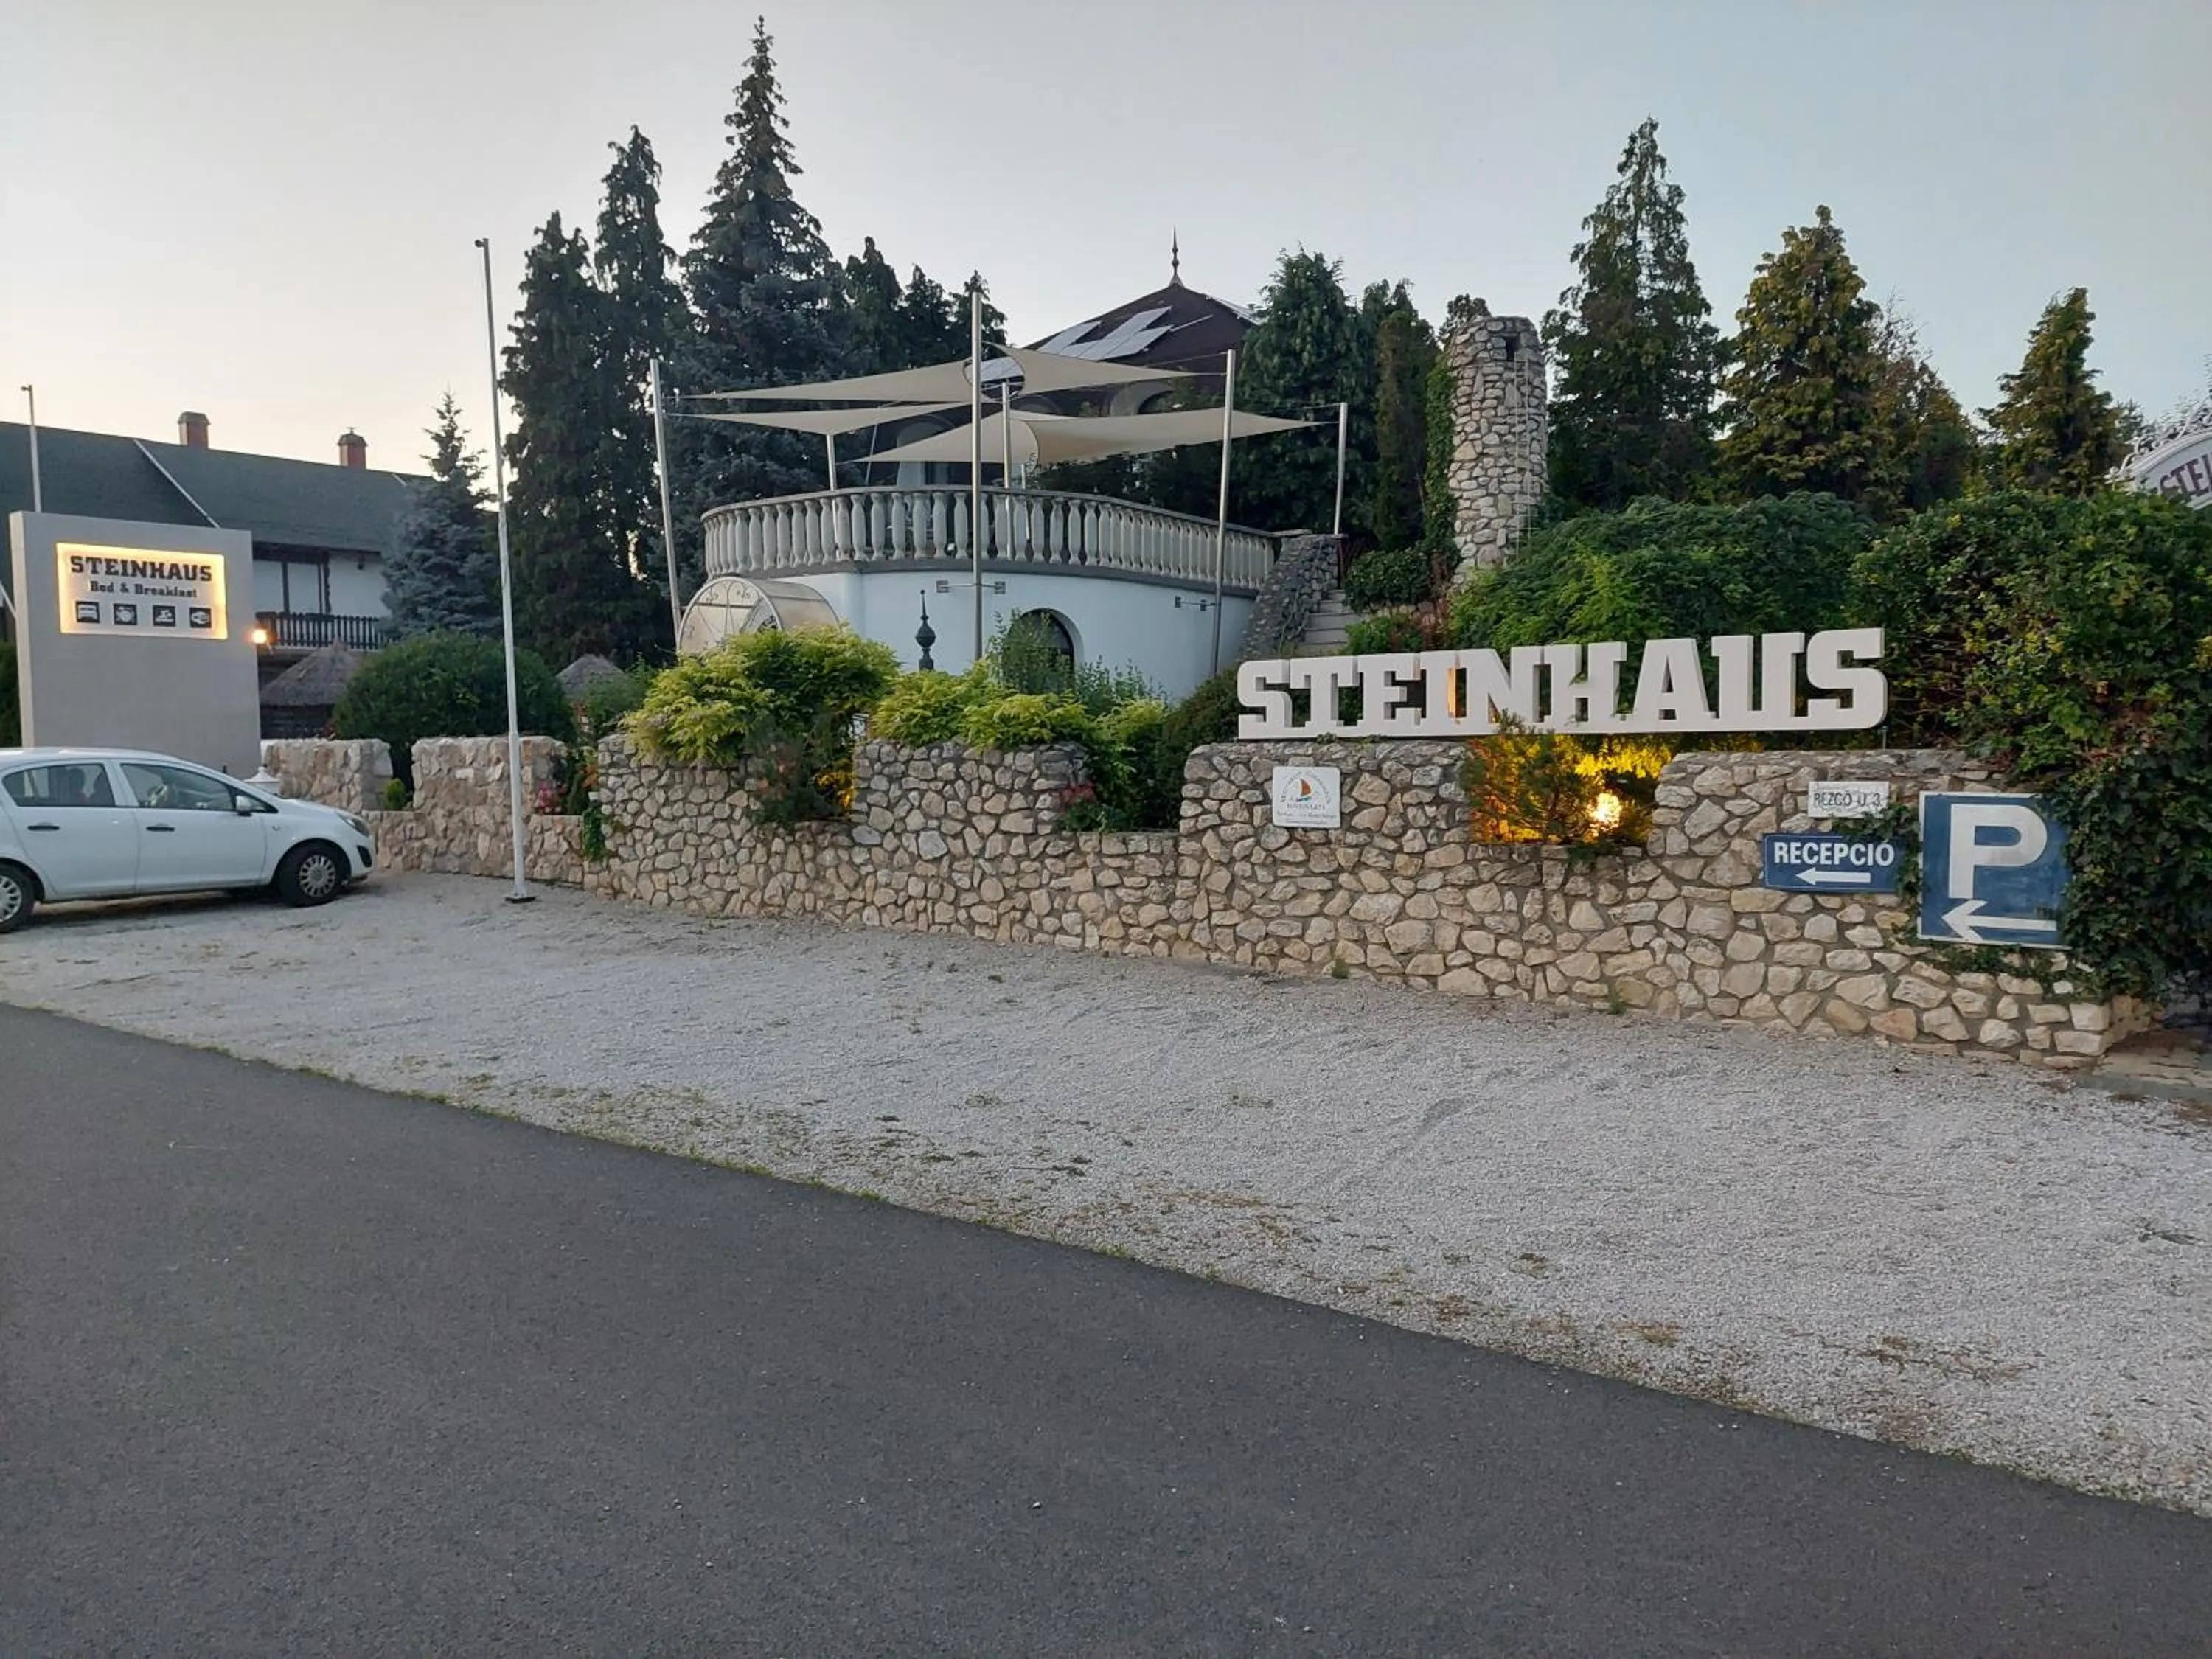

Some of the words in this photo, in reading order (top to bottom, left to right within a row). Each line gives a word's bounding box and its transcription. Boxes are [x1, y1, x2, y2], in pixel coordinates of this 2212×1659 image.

[70, 555, 212, 582] STEINHAUS
[90, 580, 114, 593] Bed
[119, 582, 130, 594] &
[133, 583, 198, 598] Breakfast
[1236, 627, 1889, 739] STEINHAUS
[1773, 838, 1895, 867] RECEPCIÓ
[1948, 803, 2048, 900] P
